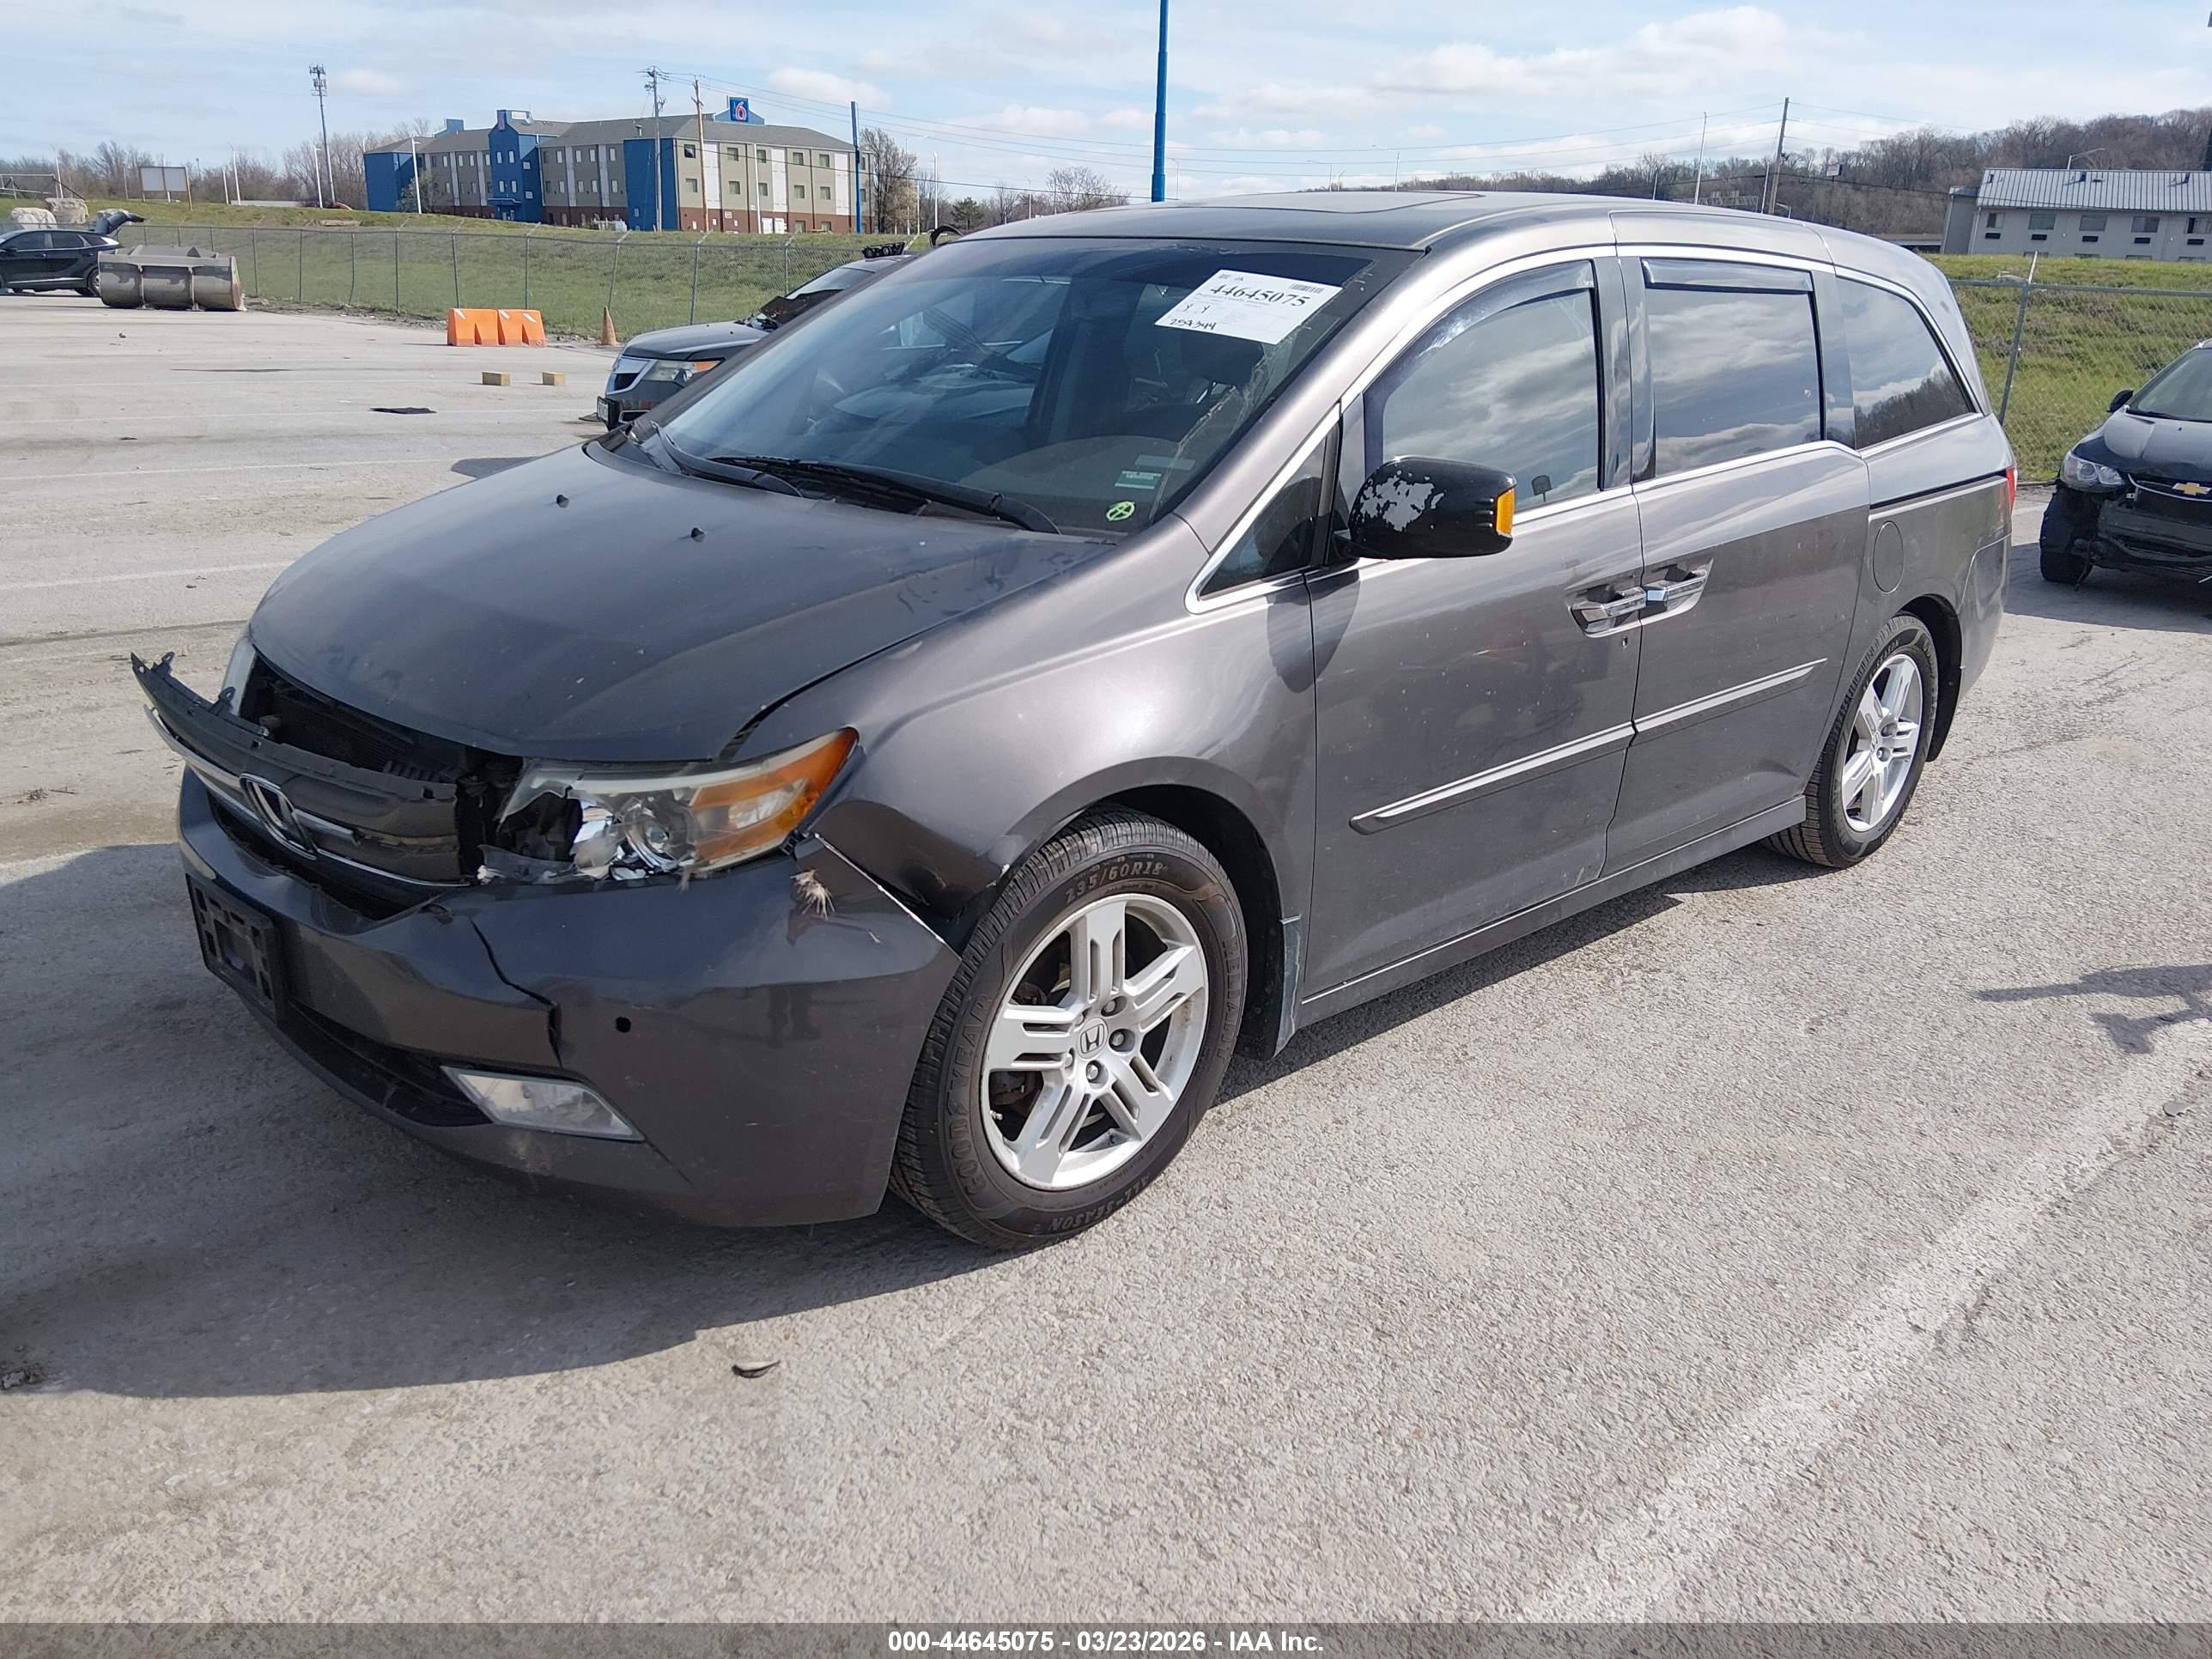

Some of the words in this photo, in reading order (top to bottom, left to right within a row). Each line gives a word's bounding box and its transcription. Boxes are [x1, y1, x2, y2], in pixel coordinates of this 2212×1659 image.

[735, 101, 747, 120] 6
[1209, 284, 1311, 307] 44645075
[1065, 860, 1163, 903] 235/60R18
[947, 994, 993, 1195] GOODYEAR
